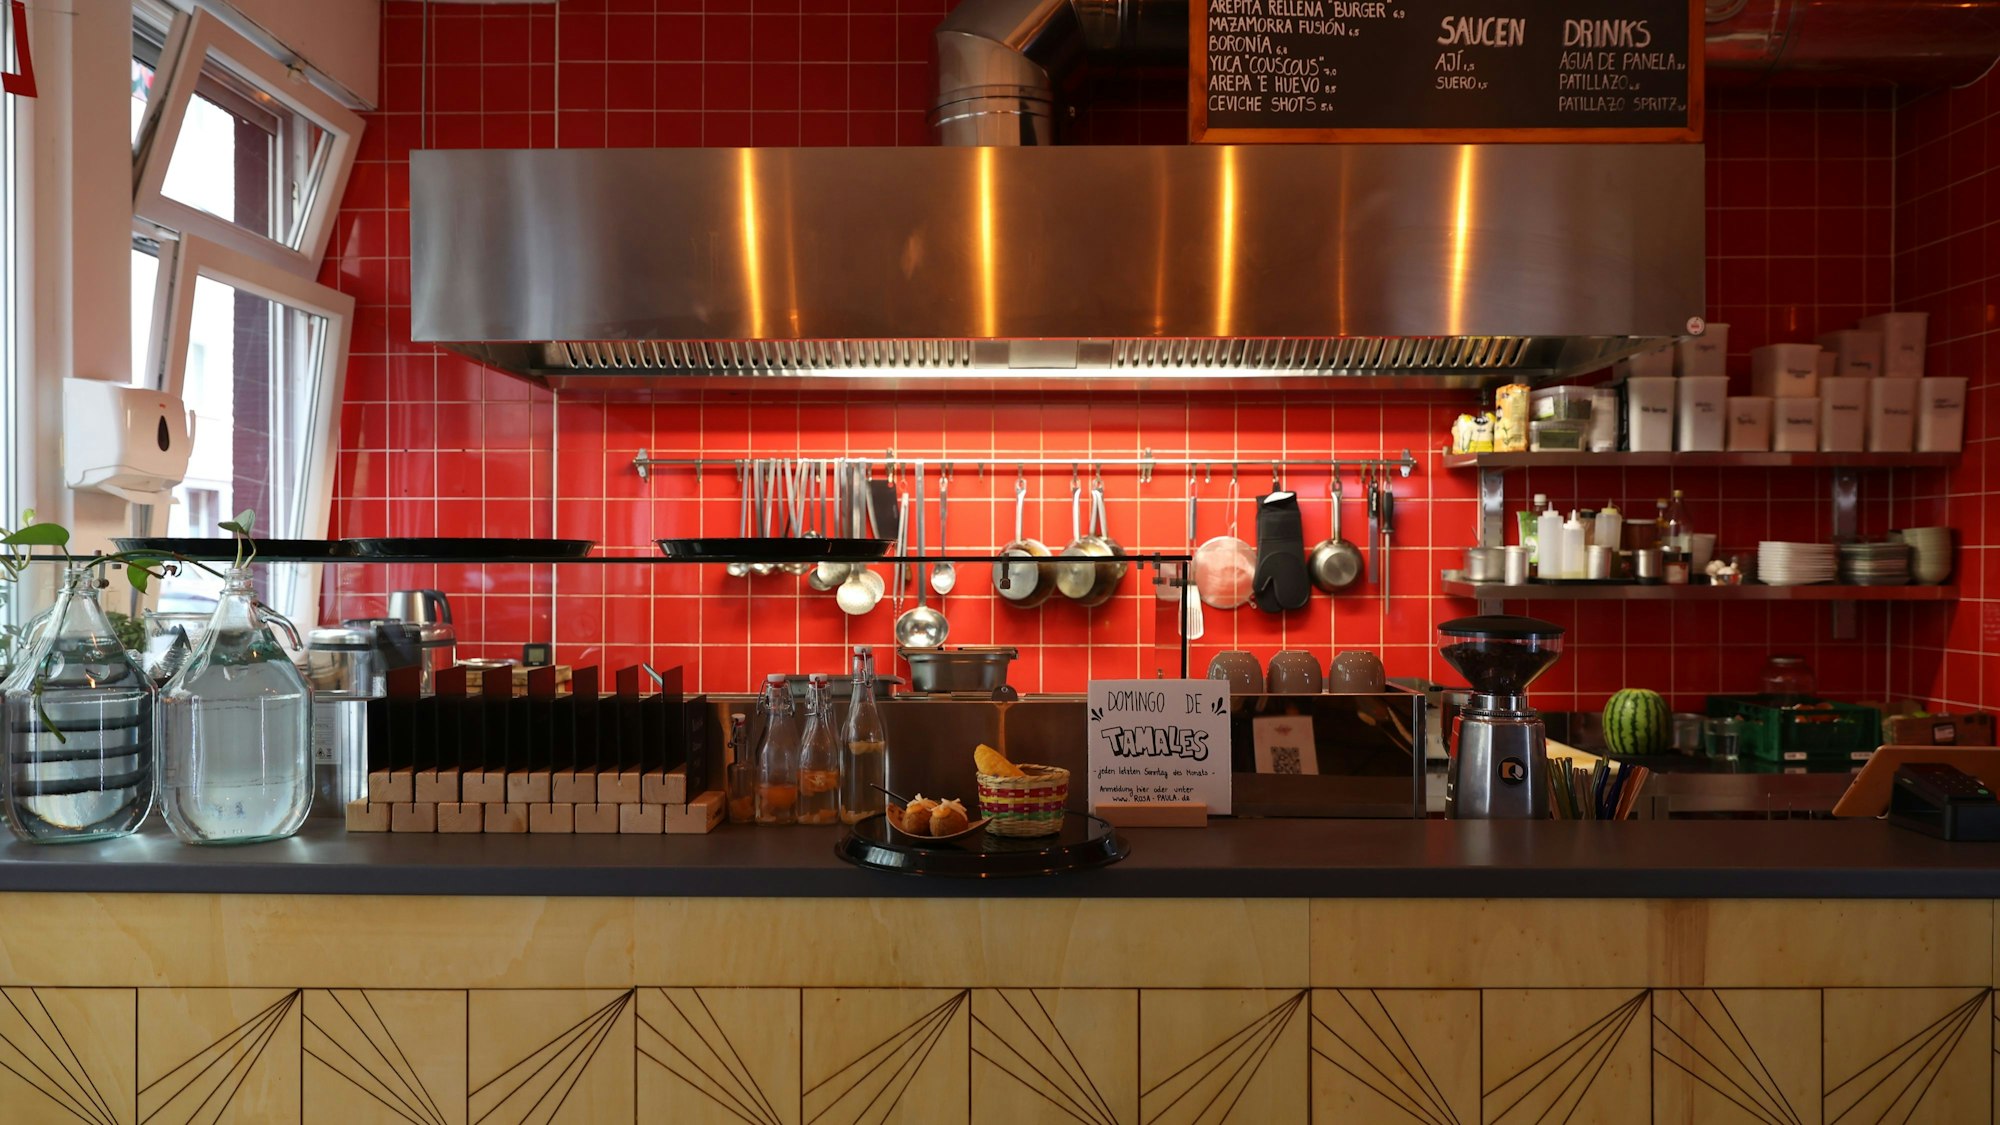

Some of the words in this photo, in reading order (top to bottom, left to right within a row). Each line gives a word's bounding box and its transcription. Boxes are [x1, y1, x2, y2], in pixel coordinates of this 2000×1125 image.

[1209, 0, 1262, 15] AREPITA
[1268, 0, 1324, 17] RELLENA
[1209, 17, 1292, 33] MAZAMORRA
[1299, 18, 1345, 36] FUSIÓN
[1437, 16, 1525, 47] SAUCEN
[1564, 19, 1651, 48] DRINKS
[1209, 34, 1272, 54] BORONÍA
[1210, 55, 1242, 73] YUCA
[1435, 50, 1464, 71] AJÍ
[1559, 51, 1593, 70] AGUA
[1598, 52, 1616, 70] DE
[1623, 52, 1675, 70] PANELA
[1209, 75, 1252, 91] AREPA
[1275, 76, 1319, 93] HUEVO
[1436, 76, 1476, 89] SUERO
[1560, 73, 1627, 90] PATILLAZO
[1209, 95, 1262, 111] CEVICHE
[1271, 96, 1316, 112] SHOTS
[1559, 96, 1624, 112] PATILLAZO
[1634, 97, 1677, 111] SPRITZ
[1108, 691, 1164, 713] DOMINGO
[1186, 694, 1202, 714] DE
[1101, 726, 1209, 761] TAMALES
[1119, 766, 1140, 775] letzten
[1144, 768, 1168, 779] Sonntag
[1100, 785, 1133, 798] Anmeldung
